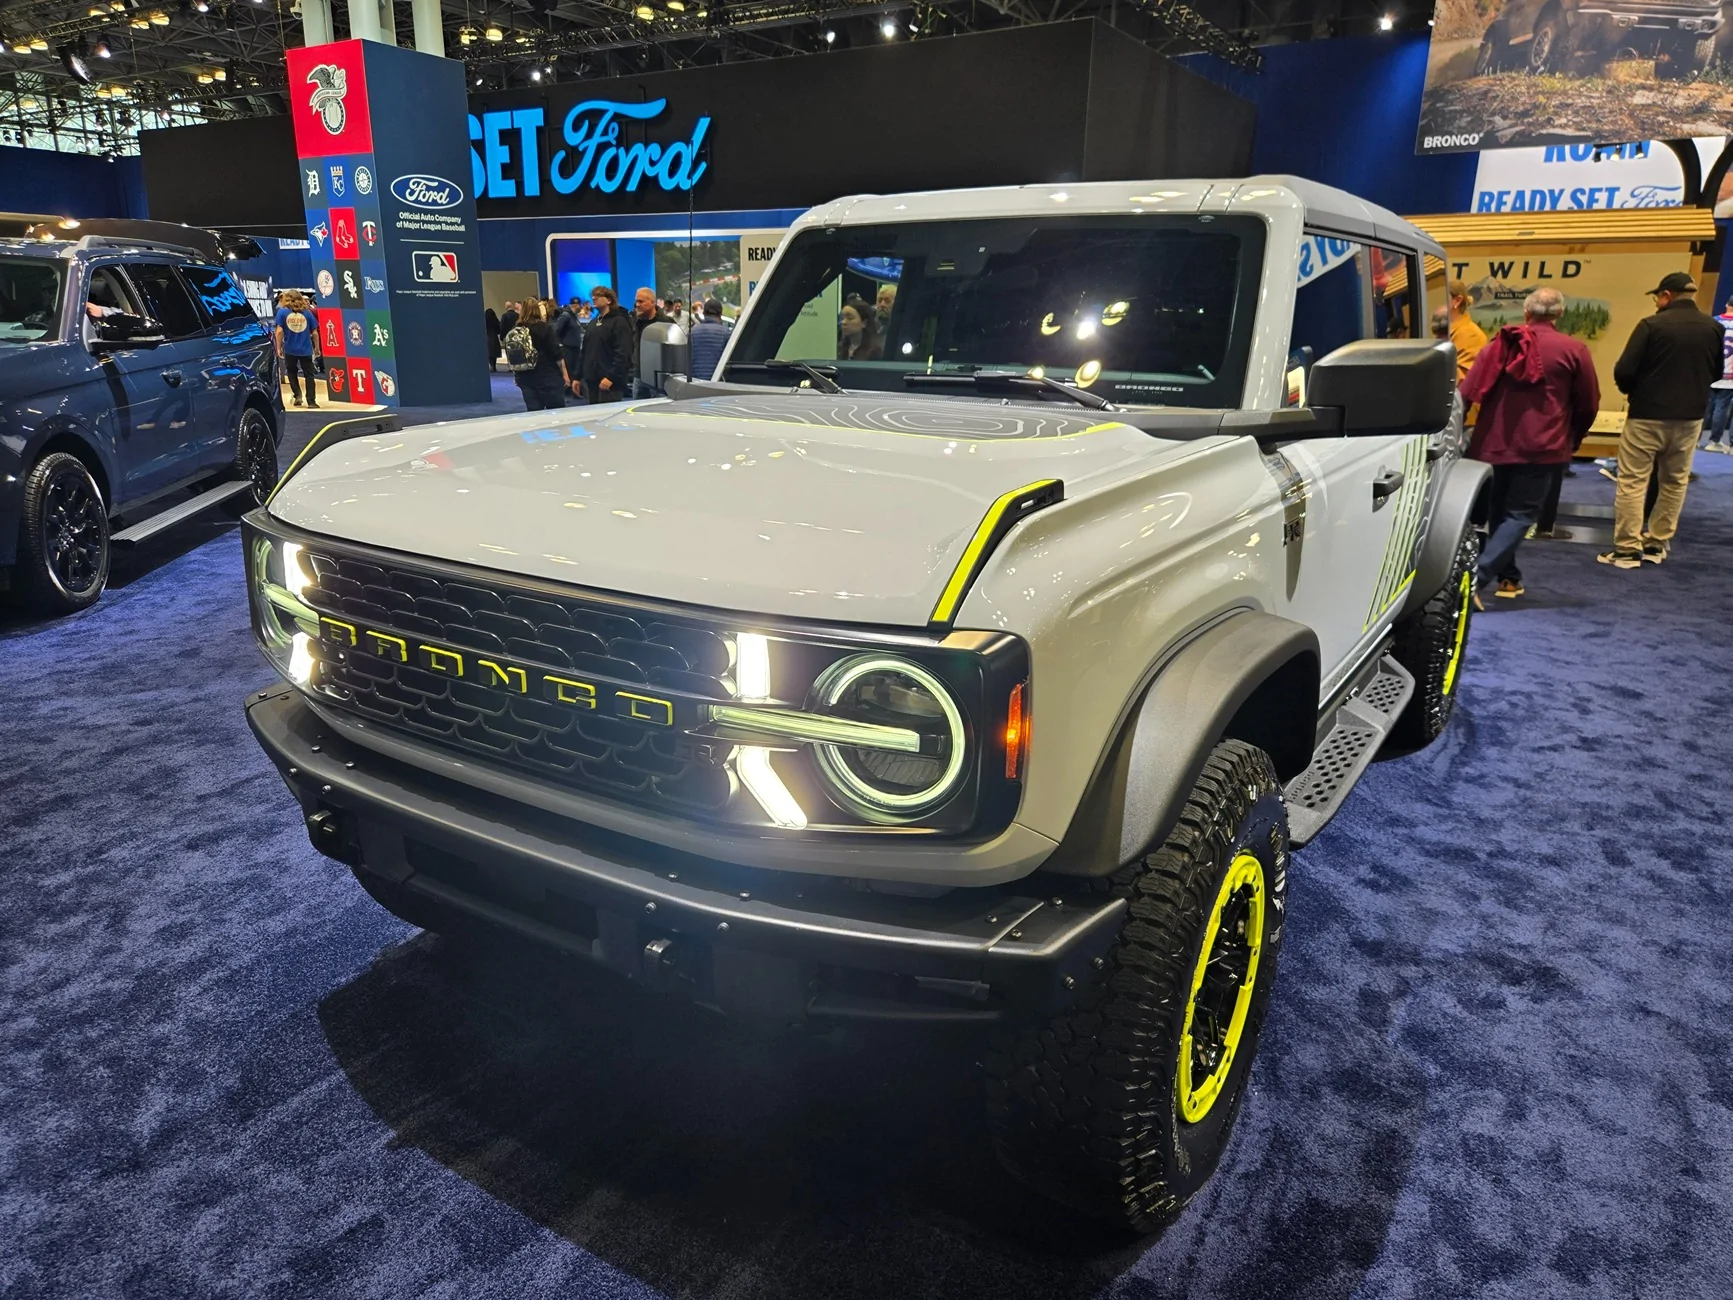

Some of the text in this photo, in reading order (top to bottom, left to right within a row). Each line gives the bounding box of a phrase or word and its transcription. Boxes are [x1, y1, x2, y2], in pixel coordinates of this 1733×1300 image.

[1424, 133, 1480, 148] BRONCO
[468, 98, 711, 199] SET Ford
[405, 178, 450, 204] Ford
[1477, 188, 1565, 213] READY
[1568, 187, 1621, 210] SET
[399, 212, 461, 224] Official Auto Company
[403, 221, 420, 230] Major
[421, 222, 441, 231] League
[442, 223, 466, 231] Baseball
[748, 247, 777, 261] READ
[1114, 384, 1184, 392] BRONCO
[317, 616, 675, 727] BRONCO
